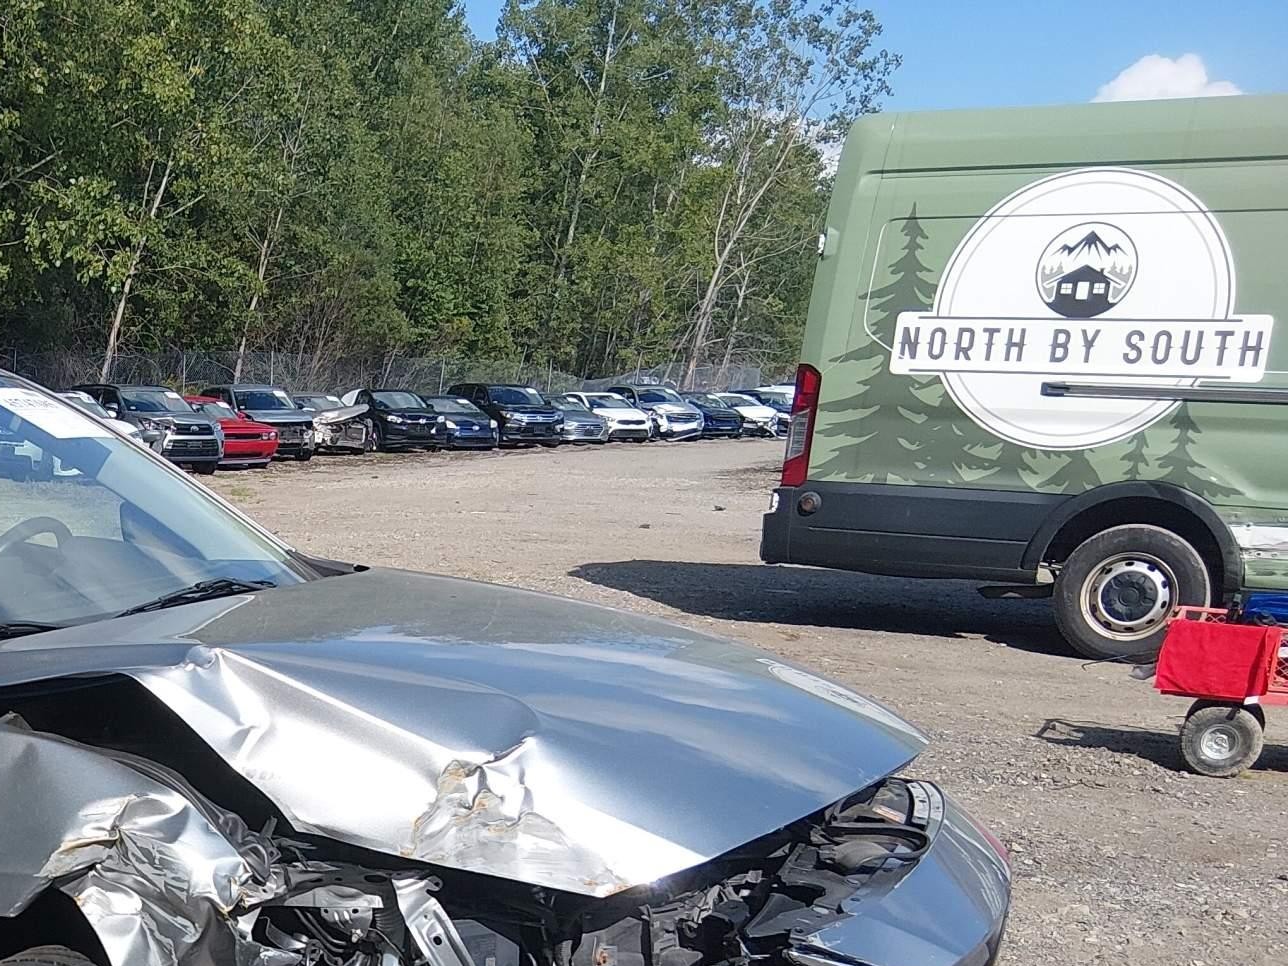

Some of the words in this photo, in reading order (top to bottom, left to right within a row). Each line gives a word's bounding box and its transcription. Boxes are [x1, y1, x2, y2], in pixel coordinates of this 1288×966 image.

[898, 326, 1027, 363] NORTH
[1048, 328, 1102, 364] BY
[1122, 329, 1265, 367] SOUTH
